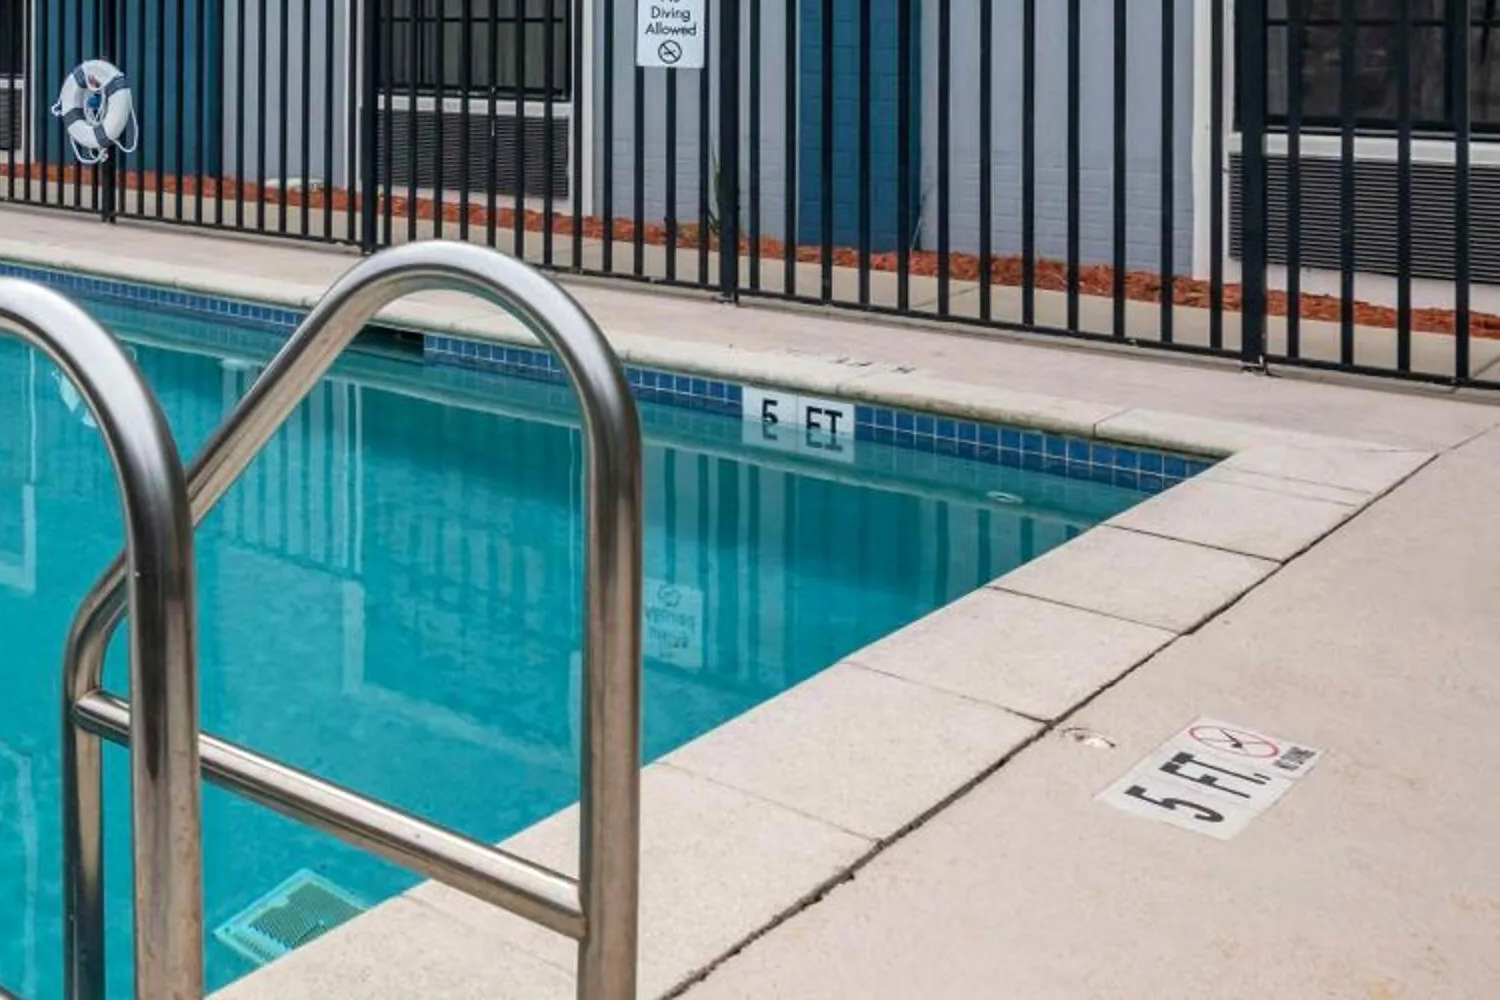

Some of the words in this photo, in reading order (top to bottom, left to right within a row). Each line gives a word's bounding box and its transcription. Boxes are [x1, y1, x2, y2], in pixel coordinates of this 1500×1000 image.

[645, 21, 697, 36] Allowed
[651, 5, 691, 23] Diving
[762, 399, 778, 425] 5
[806, 405, 843, 434] FT
[1158, 751, 1272, 799] FT.
[1123, 784, 1225, 823] 5
